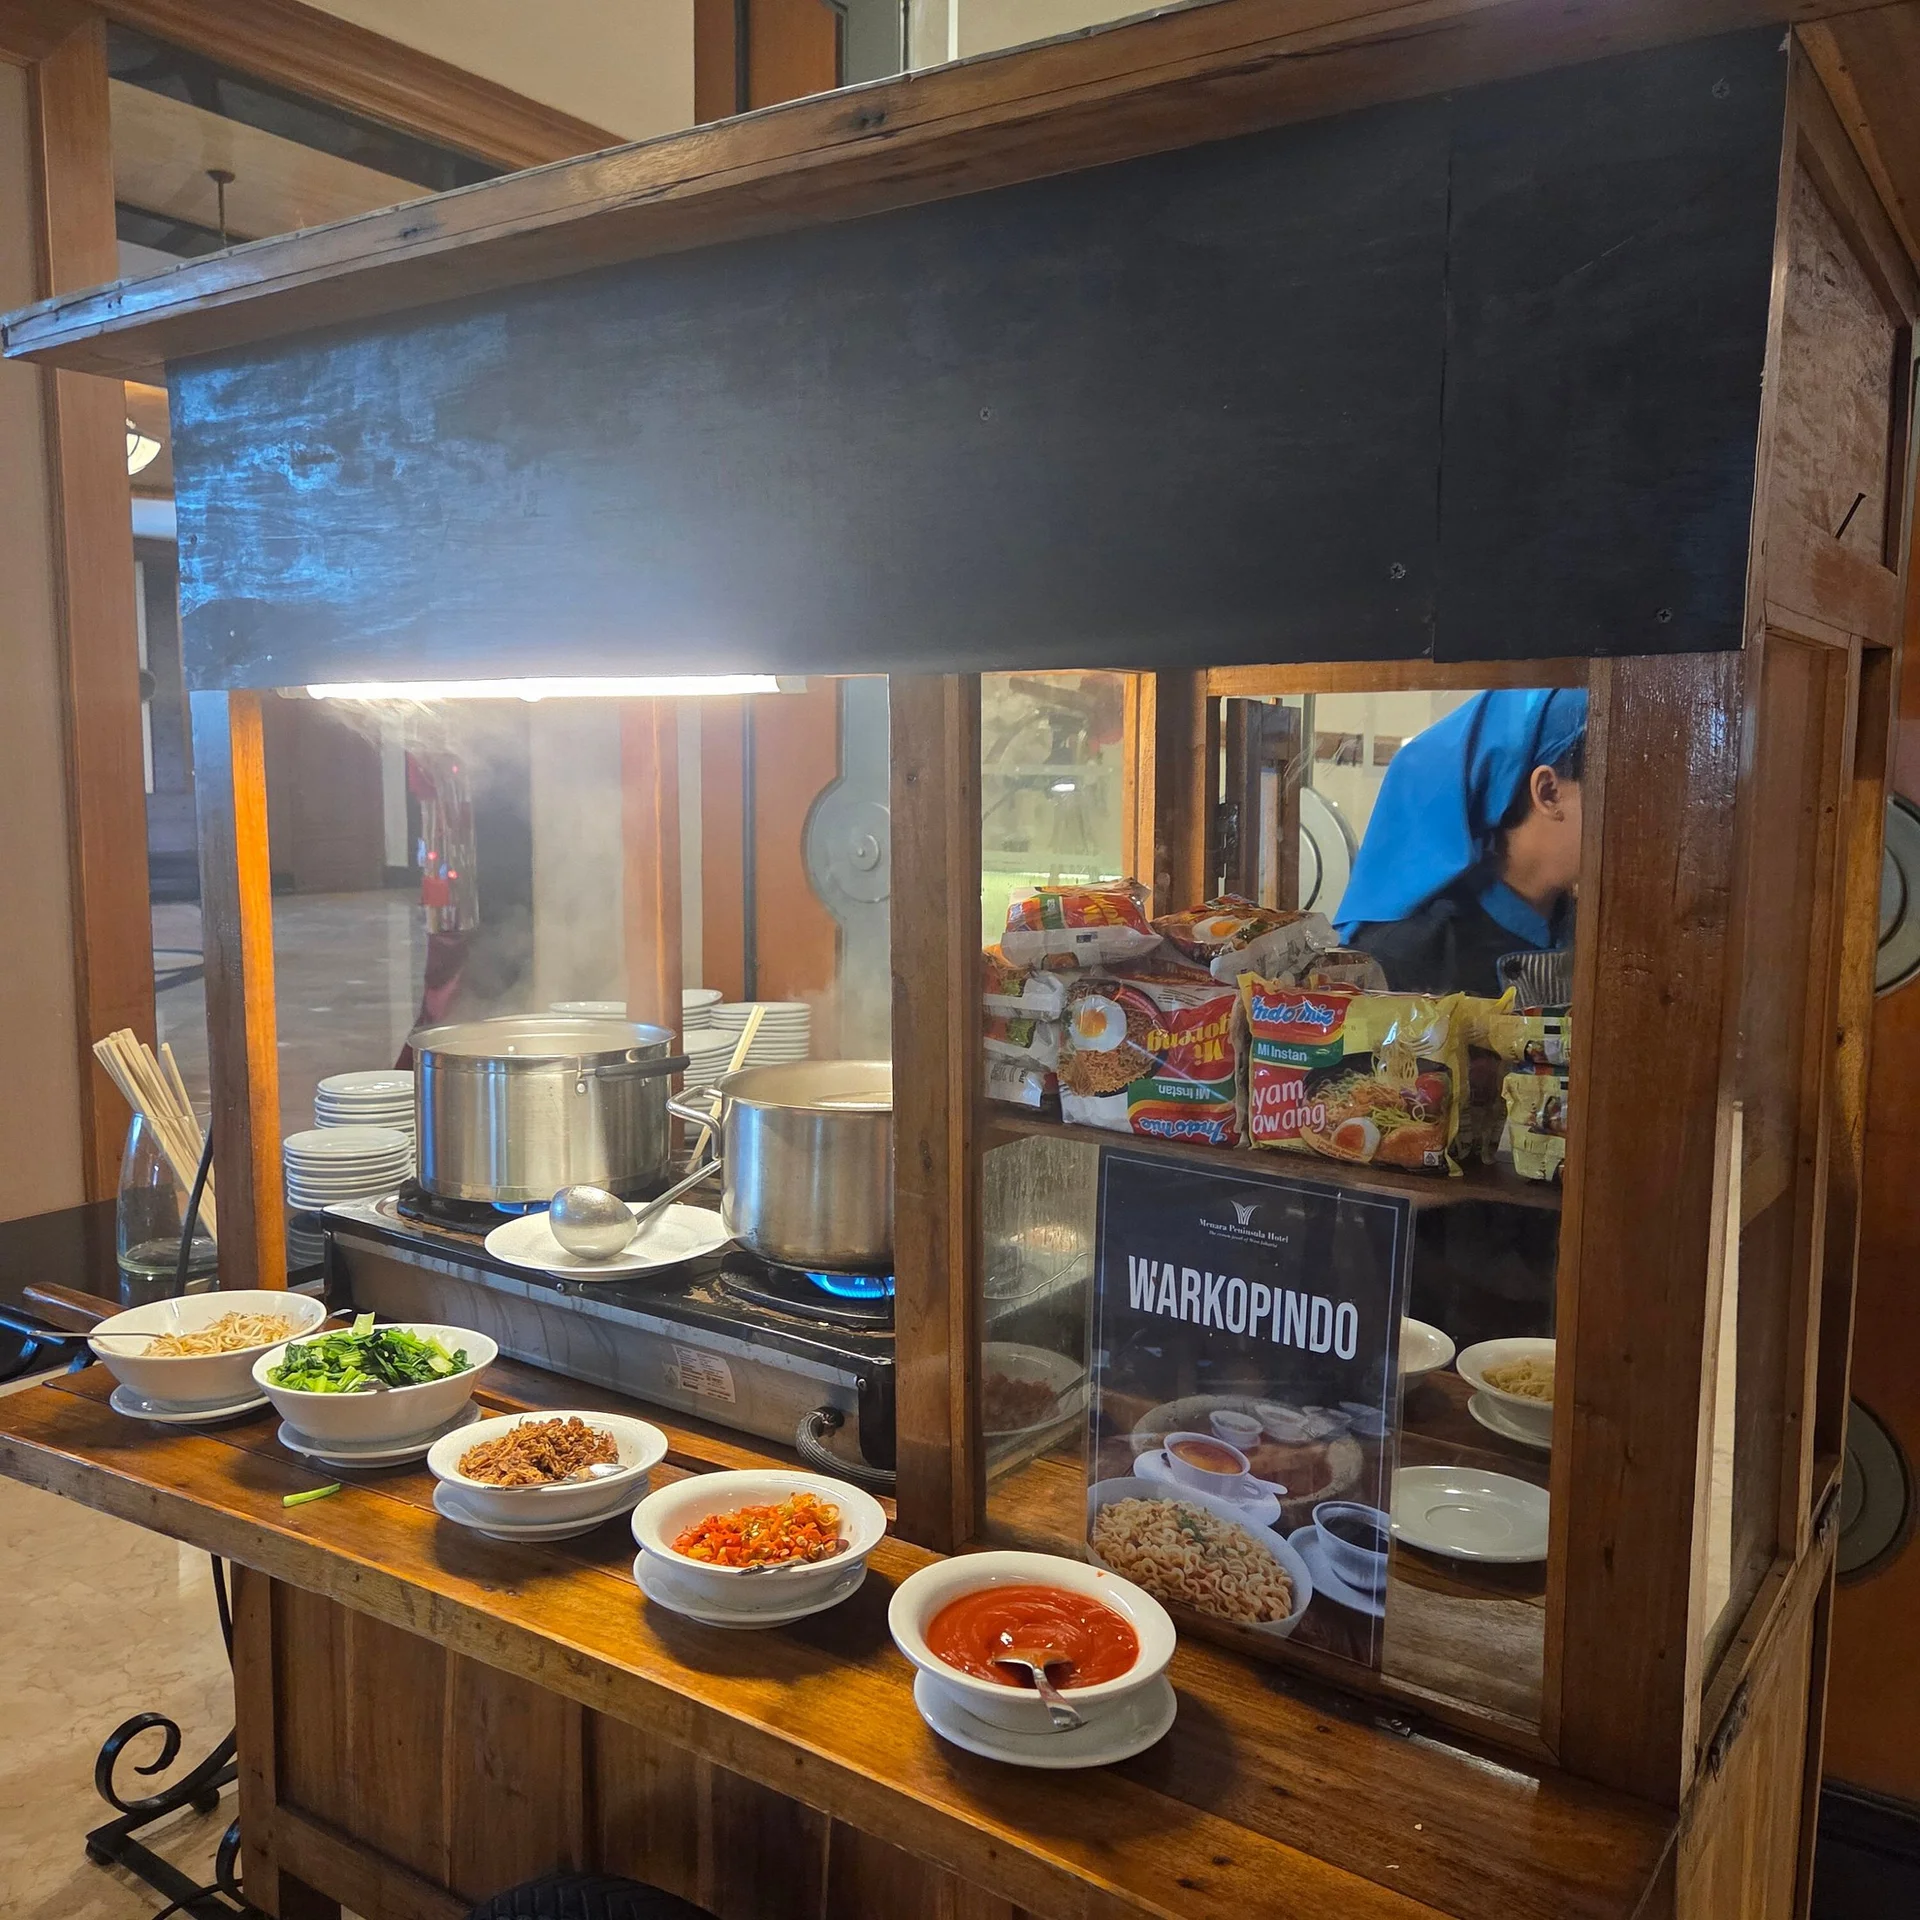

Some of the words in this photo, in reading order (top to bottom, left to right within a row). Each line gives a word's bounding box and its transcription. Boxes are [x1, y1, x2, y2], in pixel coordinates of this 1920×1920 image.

[1147, 1012, 1232, 1051] goreng
[1194, 1038, 1225, 1066] Mi
[1257, 1043, 1269, 1056] Mi
[1271, 1045, 1307, 1062] Instan
[1158, 1085, 1194, 1099] Instan
[1195, 1088, 1210, 1100] Mi
[1252, 1080, 1304, 1114] yam
[1252, 1103, 1326, 1135] awang
[1199, 1218, 1228, 1232] Menara
[1229, 1224, 1265, 1239] Peninsula
[1267, 1232, 1289, 1244] Hotel
[1128, 1255, 1358, 1361] WARKOPINDO
